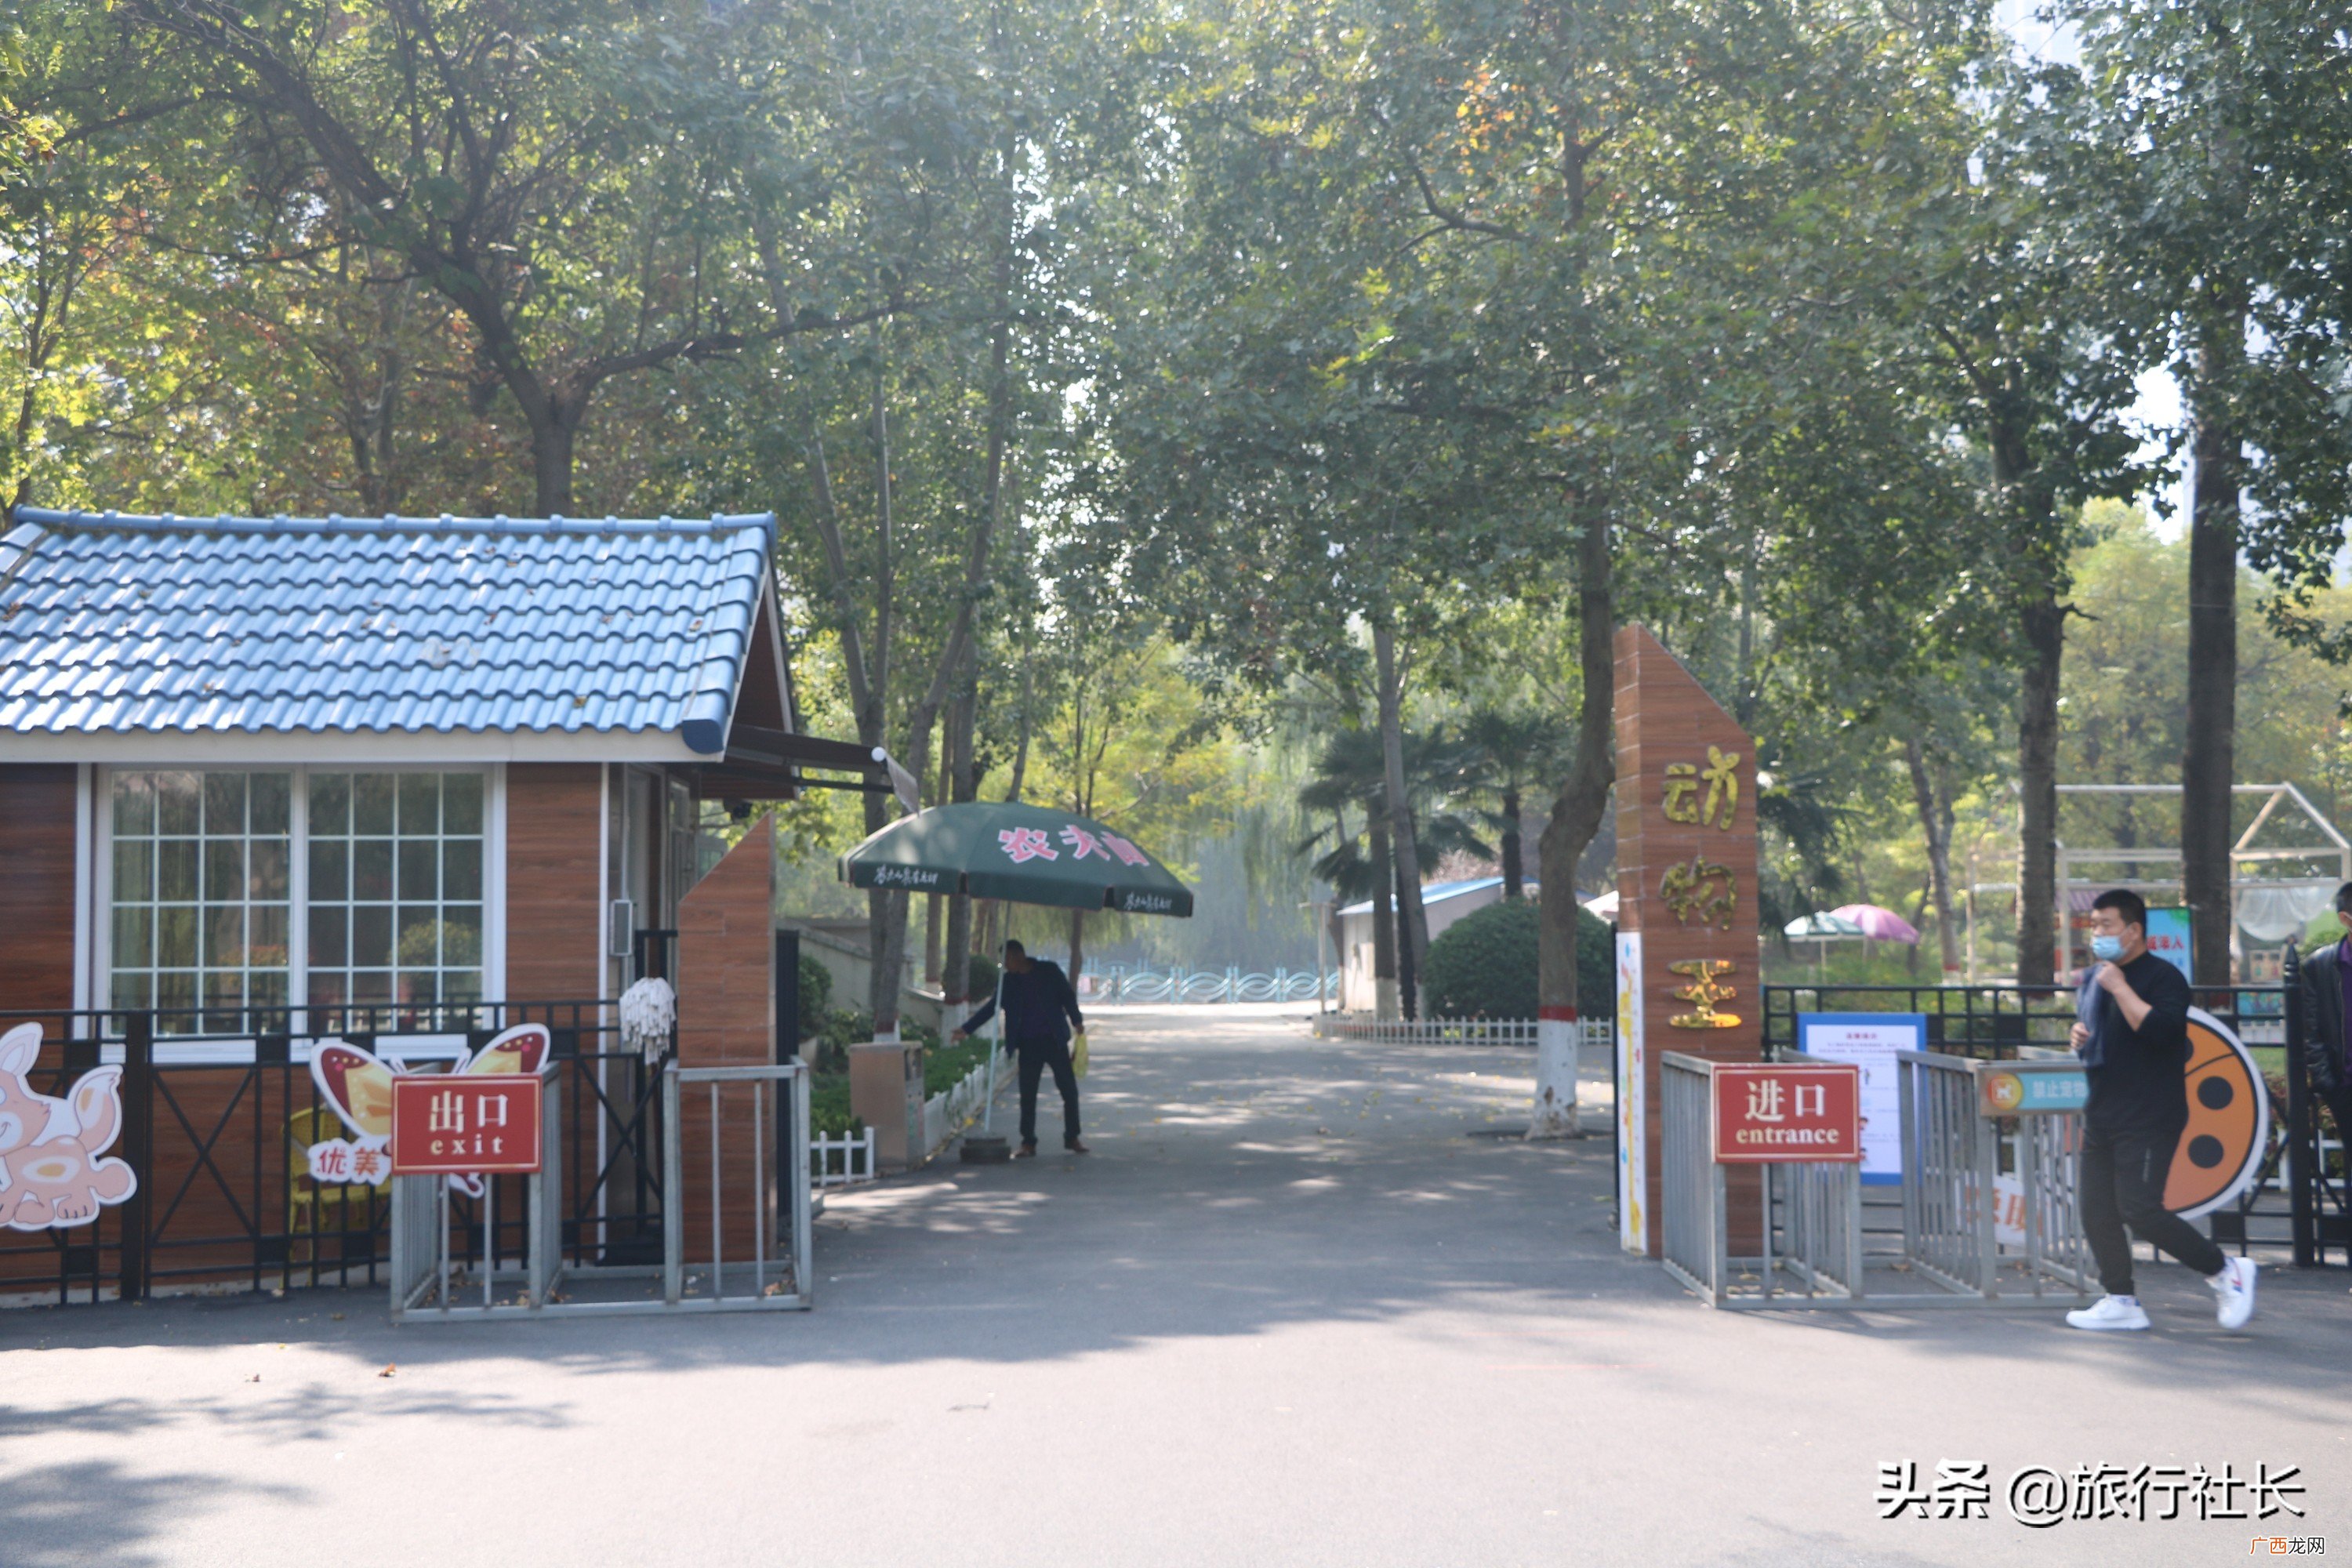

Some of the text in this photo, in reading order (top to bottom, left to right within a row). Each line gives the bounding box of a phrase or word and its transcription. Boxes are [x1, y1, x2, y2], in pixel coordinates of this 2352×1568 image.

[429, 1090, 508, 1134] 出口
[1744, 1079, 1825, 1122] 进口
[430, 1133, 503, 1155] exit
[1735, 1126, 1839, 1145] entrance
[317, 1147, 379, 1175] 优美
